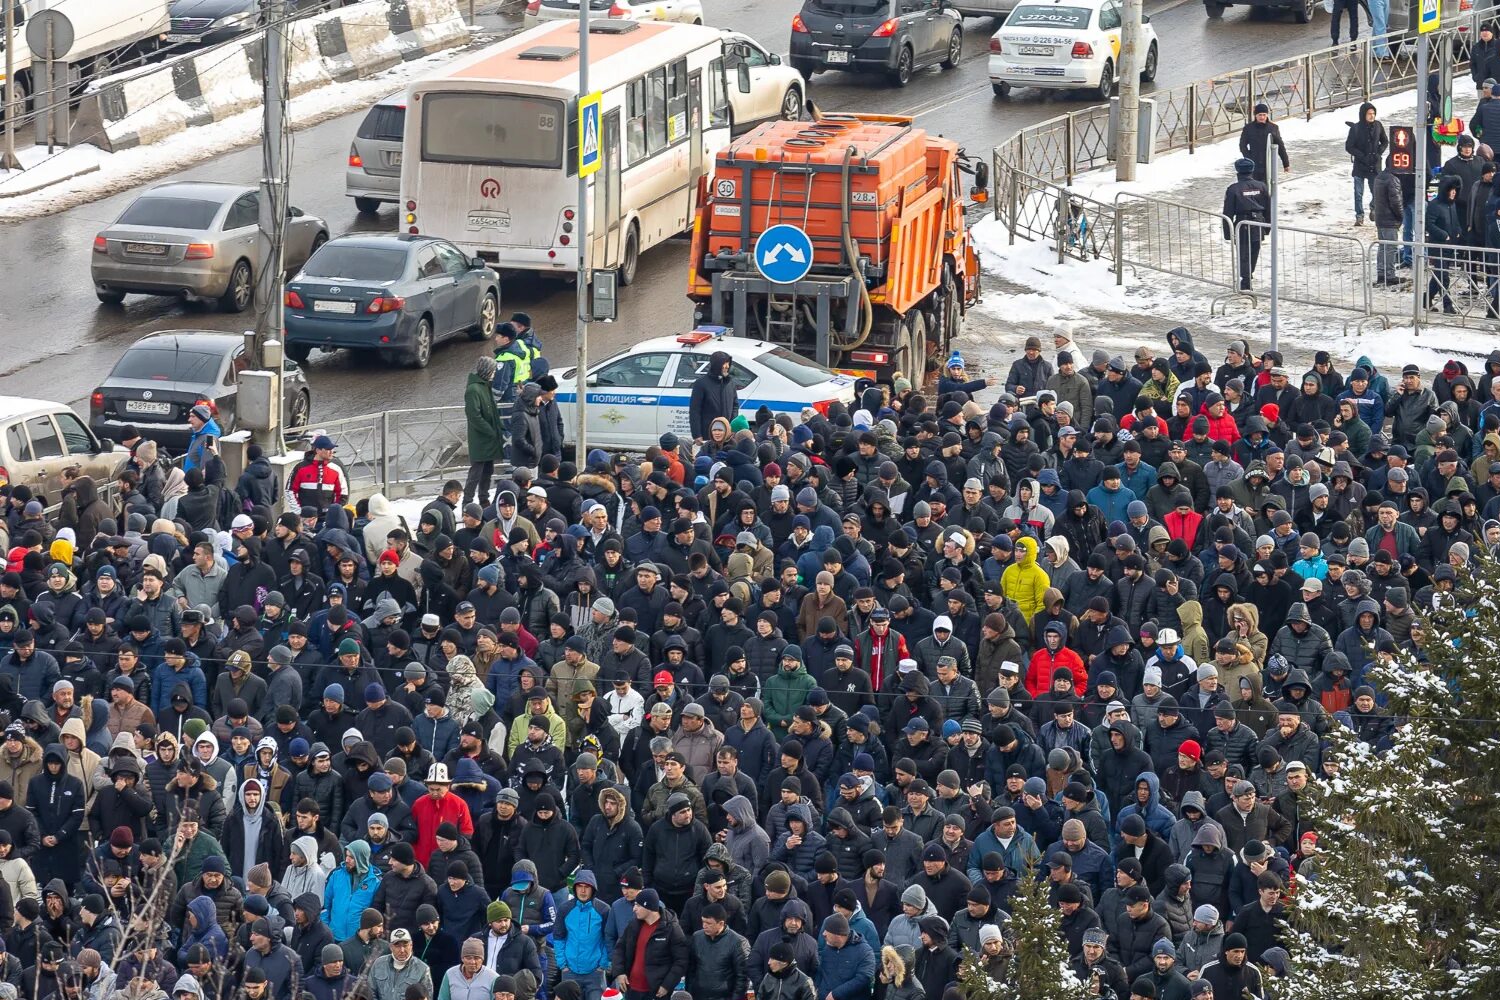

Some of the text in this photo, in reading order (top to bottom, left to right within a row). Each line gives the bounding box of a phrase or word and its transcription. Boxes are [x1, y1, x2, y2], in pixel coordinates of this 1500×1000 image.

[539, 116, 554, 128] 88
[1394, 154, 1410, 167] 59
[721, 184, 732, 193] 30
[592, 394, 637, 403] ПОЛИЦИЯ
